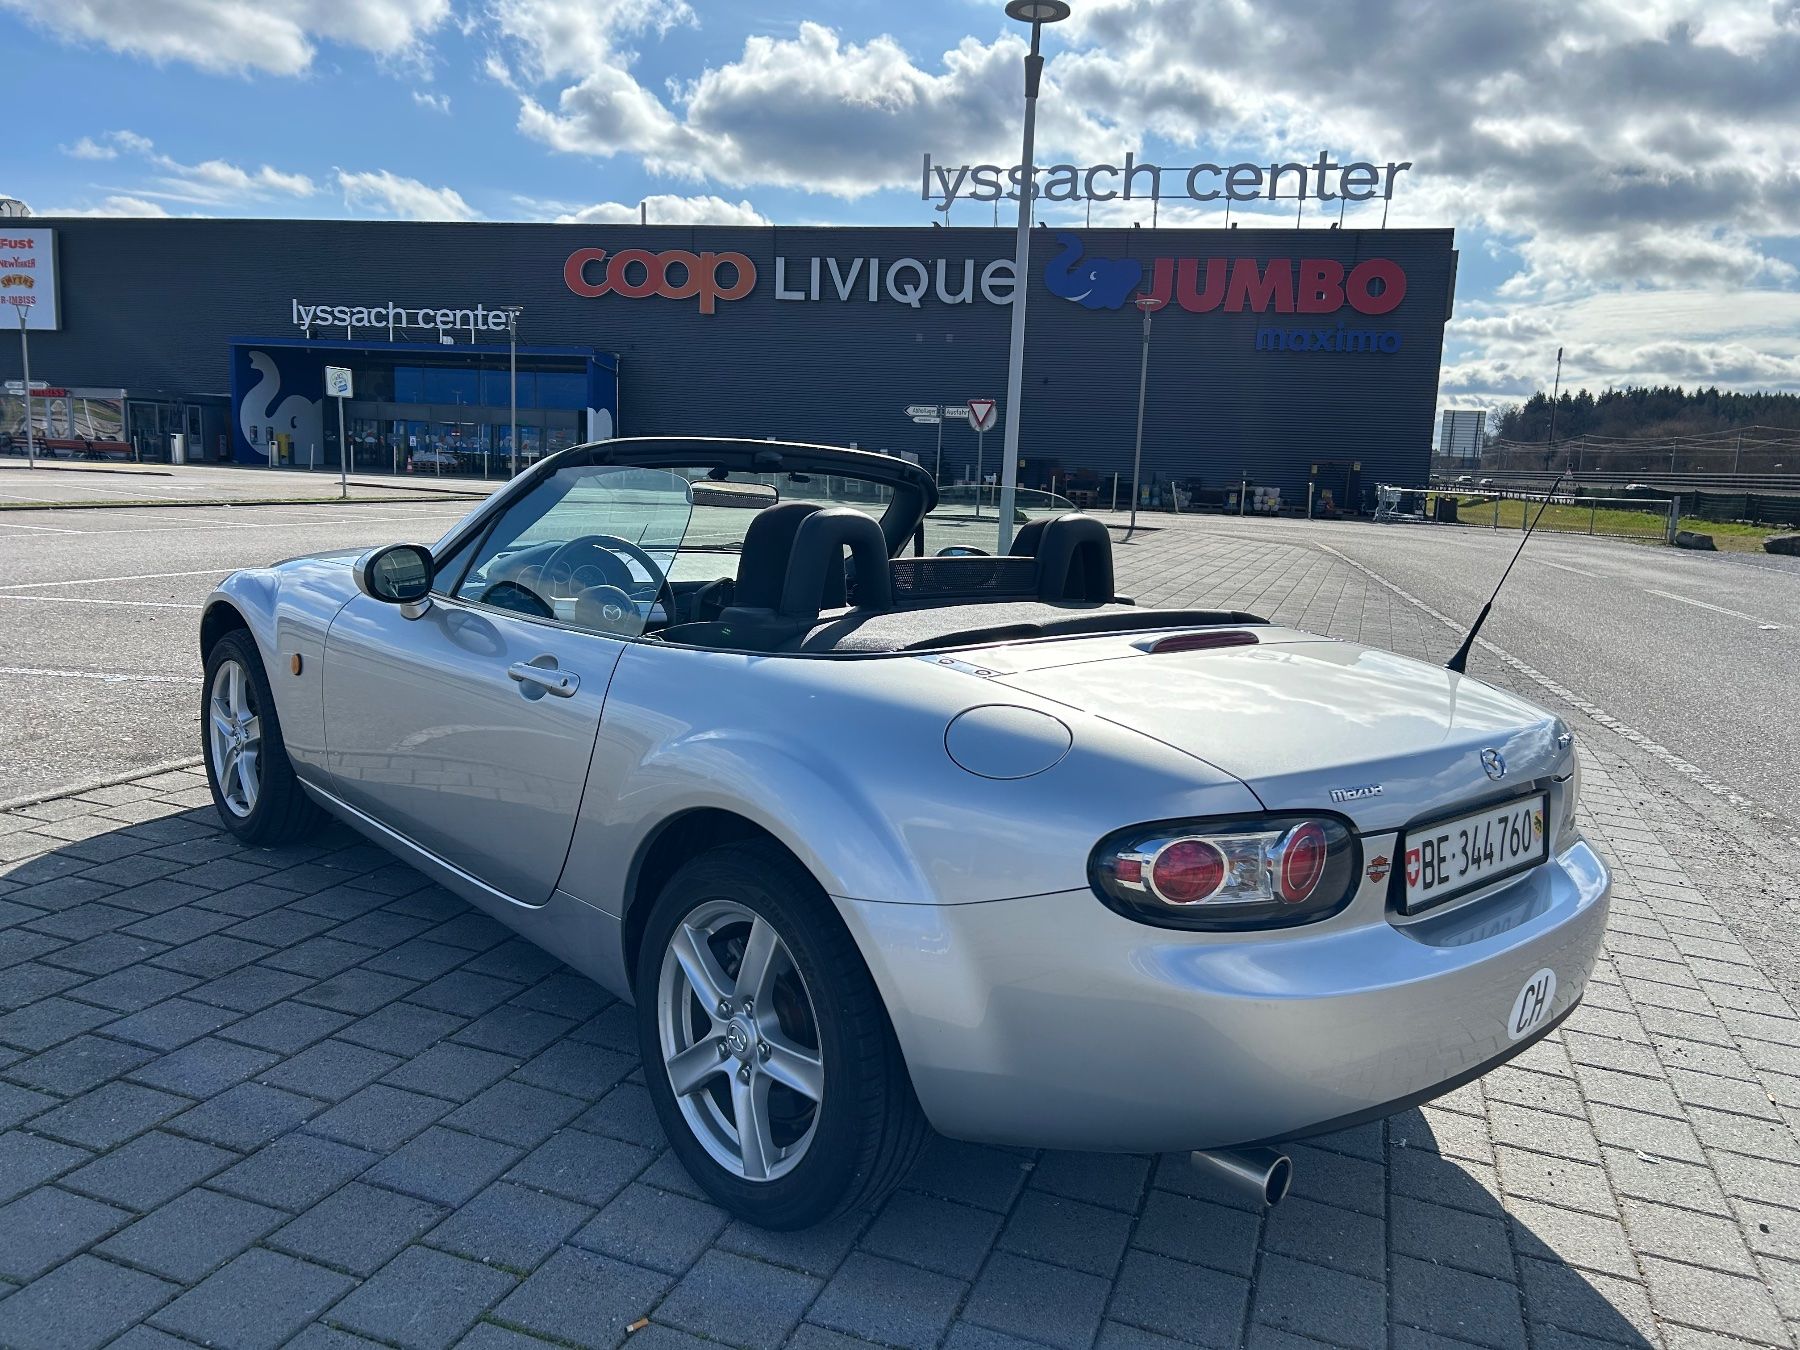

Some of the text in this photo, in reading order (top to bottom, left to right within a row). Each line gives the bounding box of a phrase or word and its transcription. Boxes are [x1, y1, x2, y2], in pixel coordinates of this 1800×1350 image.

[921, 151, 1413, 211] lyssach center
[563, 247, 757, 314] coop
[1137, 258, 1407, 315] JUMBO
[292, 299, 407, 330] lyssach
[1255, 322, 1402, 353] maximo
[1515, 975, 1549, 1034] CH
